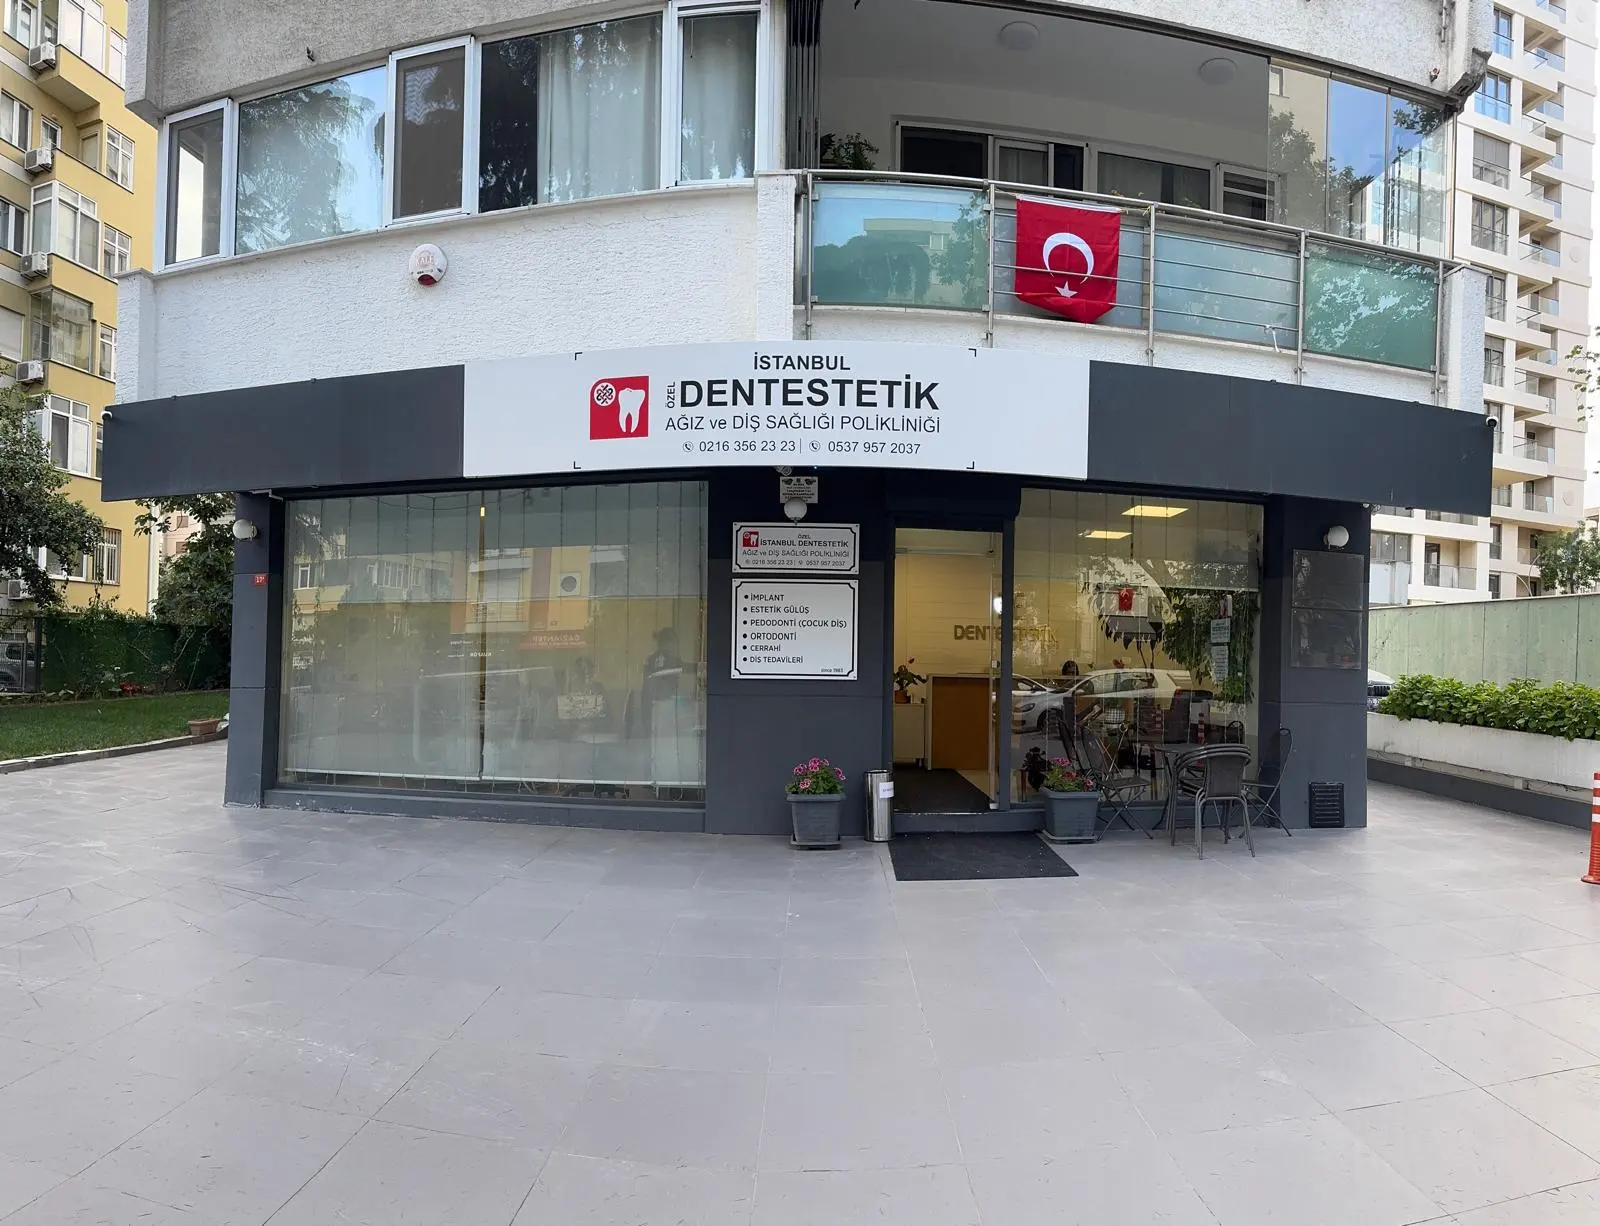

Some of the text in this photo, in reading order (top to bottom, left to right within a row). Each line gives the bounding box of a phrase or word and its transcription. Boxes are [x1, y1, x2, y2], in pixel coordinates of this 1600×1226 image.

[753, 351, 851, 371] İSTANBUL
[665, 381, 677, 409] ÖZEL
[680, 373, 940, 411] DENTESTETİK
[665, 412, 940, 433] AĞIZ ve DİŞ SAĞLIĞI POLİKLİNİĞİ
[699, 440, 921, 454] 0216 356 23 23 0537 957 2037
[760, 539, 849, 548] İSTANBUL DENTESTETİK
[768, 548, 780, 558] DİŞ
[781, 549, 809, 557] SAĞLIĞI
[750, 593, 785, 602] İMPLANT
[750, 605, 810, 615] ESTETİK GÜLÜŞ
[750, 619, 797, 627] PEDODONTİ
[798, 620, 829, 628] (ÇOCUK
[750, 632, 797, 641] ORTODONTİ
[750, 644, 781, 652] CERRAHİ
[750, 655, 804, 664] DİŞ TEDAVİLERİ
